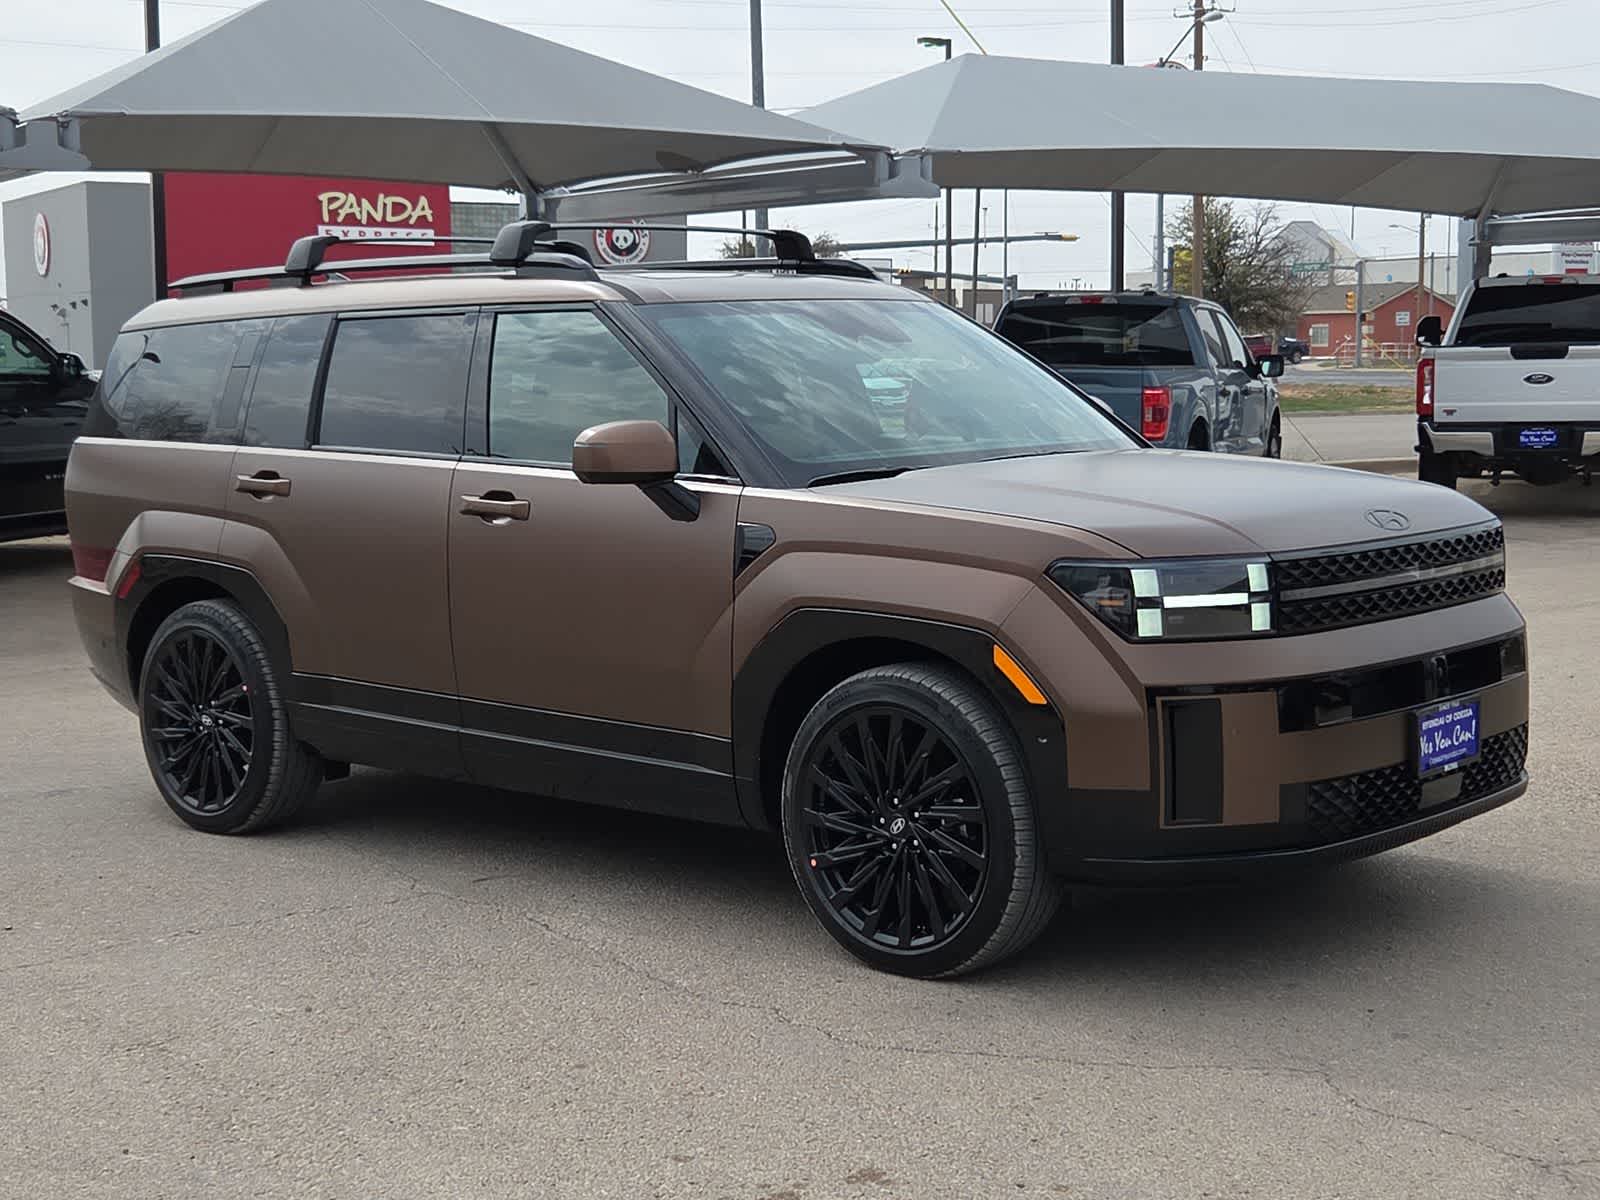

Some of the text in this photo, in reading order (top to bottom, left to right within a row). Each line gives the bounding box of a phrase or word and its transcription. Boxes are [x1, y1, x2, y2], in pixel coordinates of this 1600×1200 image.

[318, 192, 433, 225] PANDA
[1419, 735, 1433, 757] Yes
[1434, 730, 1452, 752] You
[1453, 719, 1476, 746] Can!
